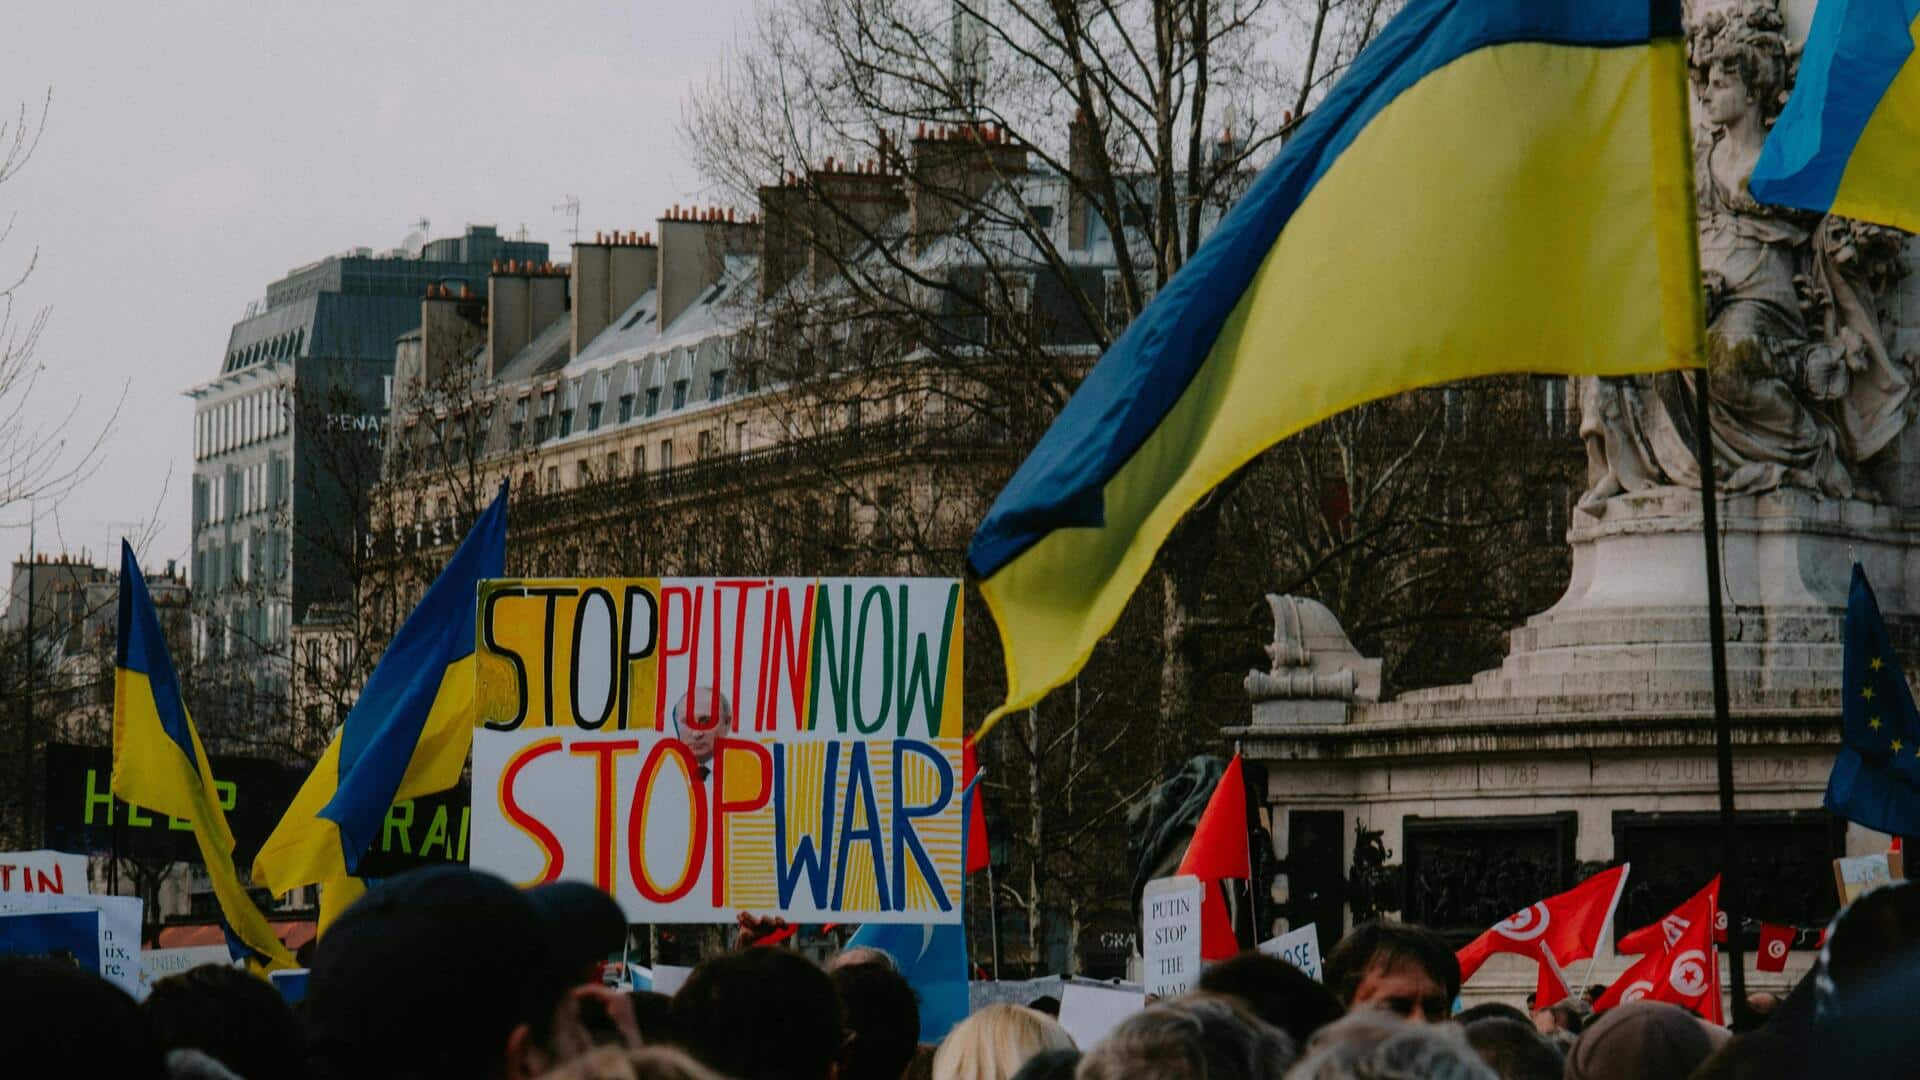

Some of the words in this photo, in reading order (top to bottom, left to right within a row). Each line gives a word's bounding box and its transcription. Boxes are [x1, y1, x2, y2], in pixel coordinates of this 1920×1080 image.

[484, 587, 657, 732] STOP
[807, 584, 960, 737] NOW
[498, 737, 773, 908] STOP
[774, 739, 953, 911] WAR
[1152, 897, 1190, 919] PUTIN
[1154, 925, 1187, 945] STOP
[1159, 956, 1183, 976] THE
